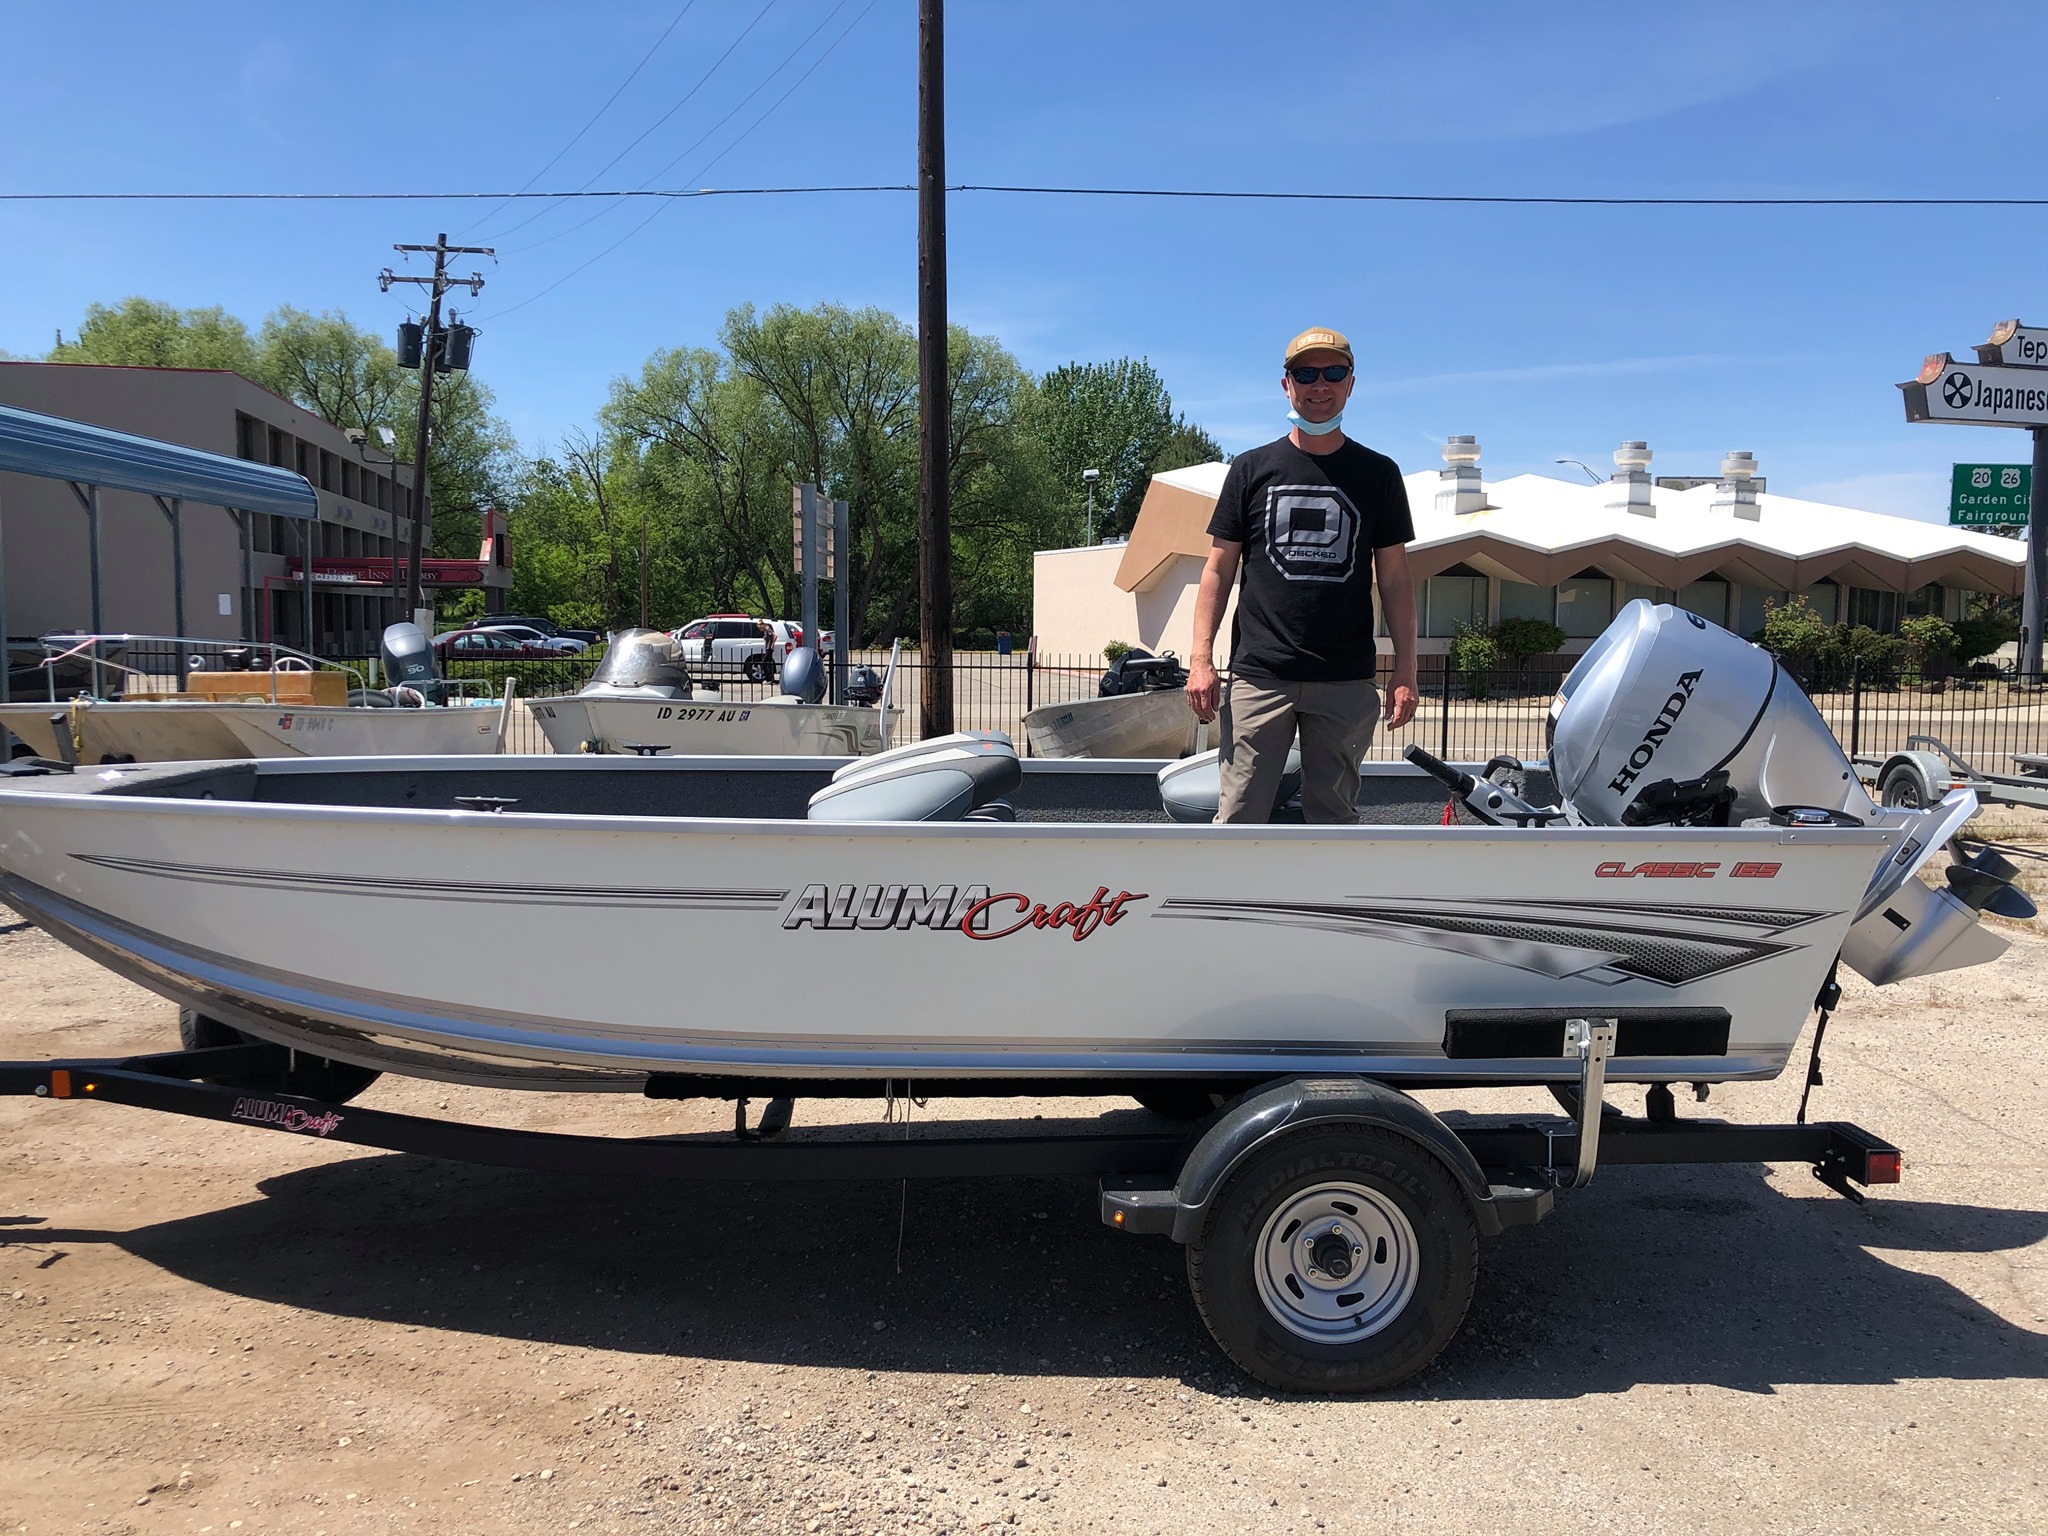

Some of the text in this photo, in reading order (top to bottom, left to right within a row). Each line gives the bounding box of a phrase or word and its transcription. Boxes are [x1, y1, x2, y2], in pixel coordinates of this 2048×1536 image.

[1974, 379, 2048, 414] Japanes
[1973, 472, 2018, 484] 20 26
[1959, 494, 2007, 505] Garden
[1958, 510, 2031, 523] Fairgroun
[1288, 550, 1337, 559] DECKED
[315, 573, 355, 583] CLEARANCE
[401, 569, 438, 580] LBBY
[656, 707, 735, 722] ID 2977 AU
[1607, 668, 1704, 796] HONDA
[1594, 862, 1782, 878] CLASSIC 165
